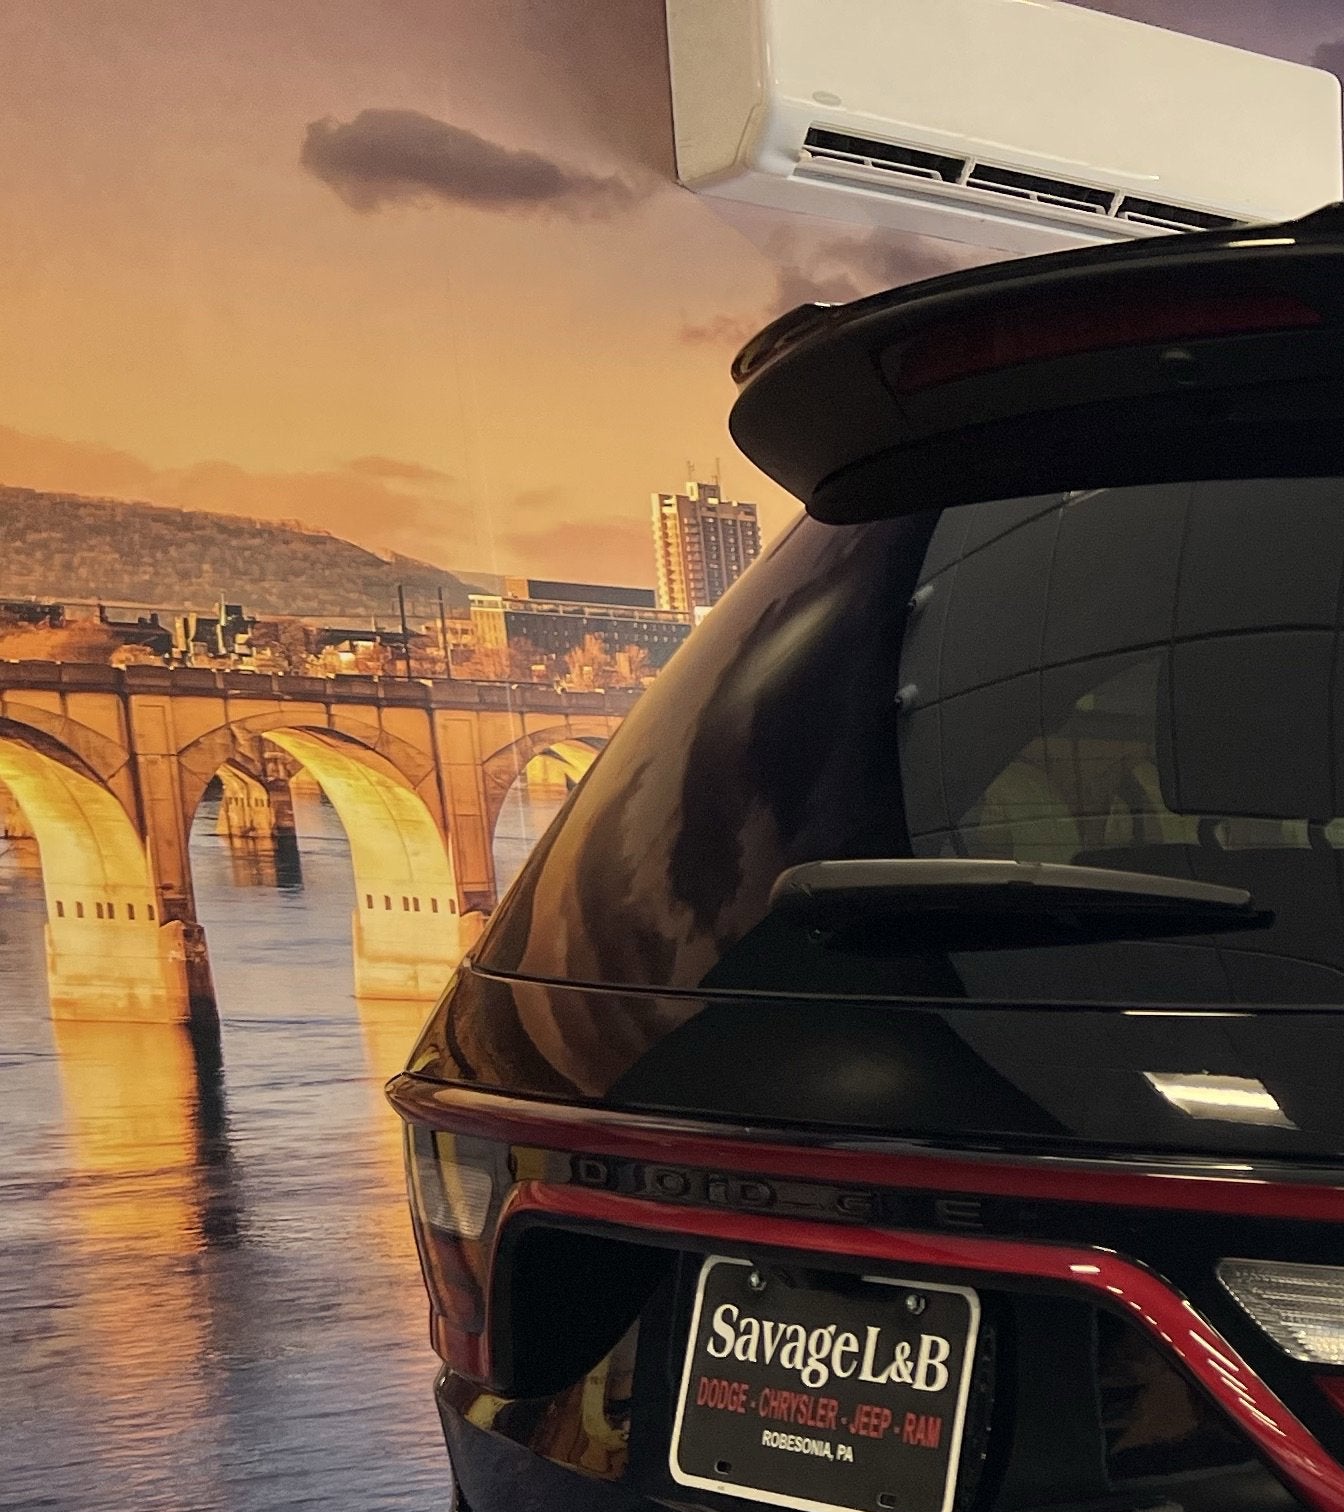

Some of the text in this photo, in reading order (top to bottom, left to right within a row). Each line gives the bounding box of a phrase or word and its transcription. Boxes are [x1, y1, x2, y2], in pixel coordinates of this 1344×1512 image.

[697, 1376, 747, 1414] DODGE
[758, 1386, 840, 1431] CHRYSLER
[849, 1403, 892, 1439] JEEP
[903, 1412, 942, 1449] RAM
[761, 1429, 854, 1463] ROBESONIA, PA
